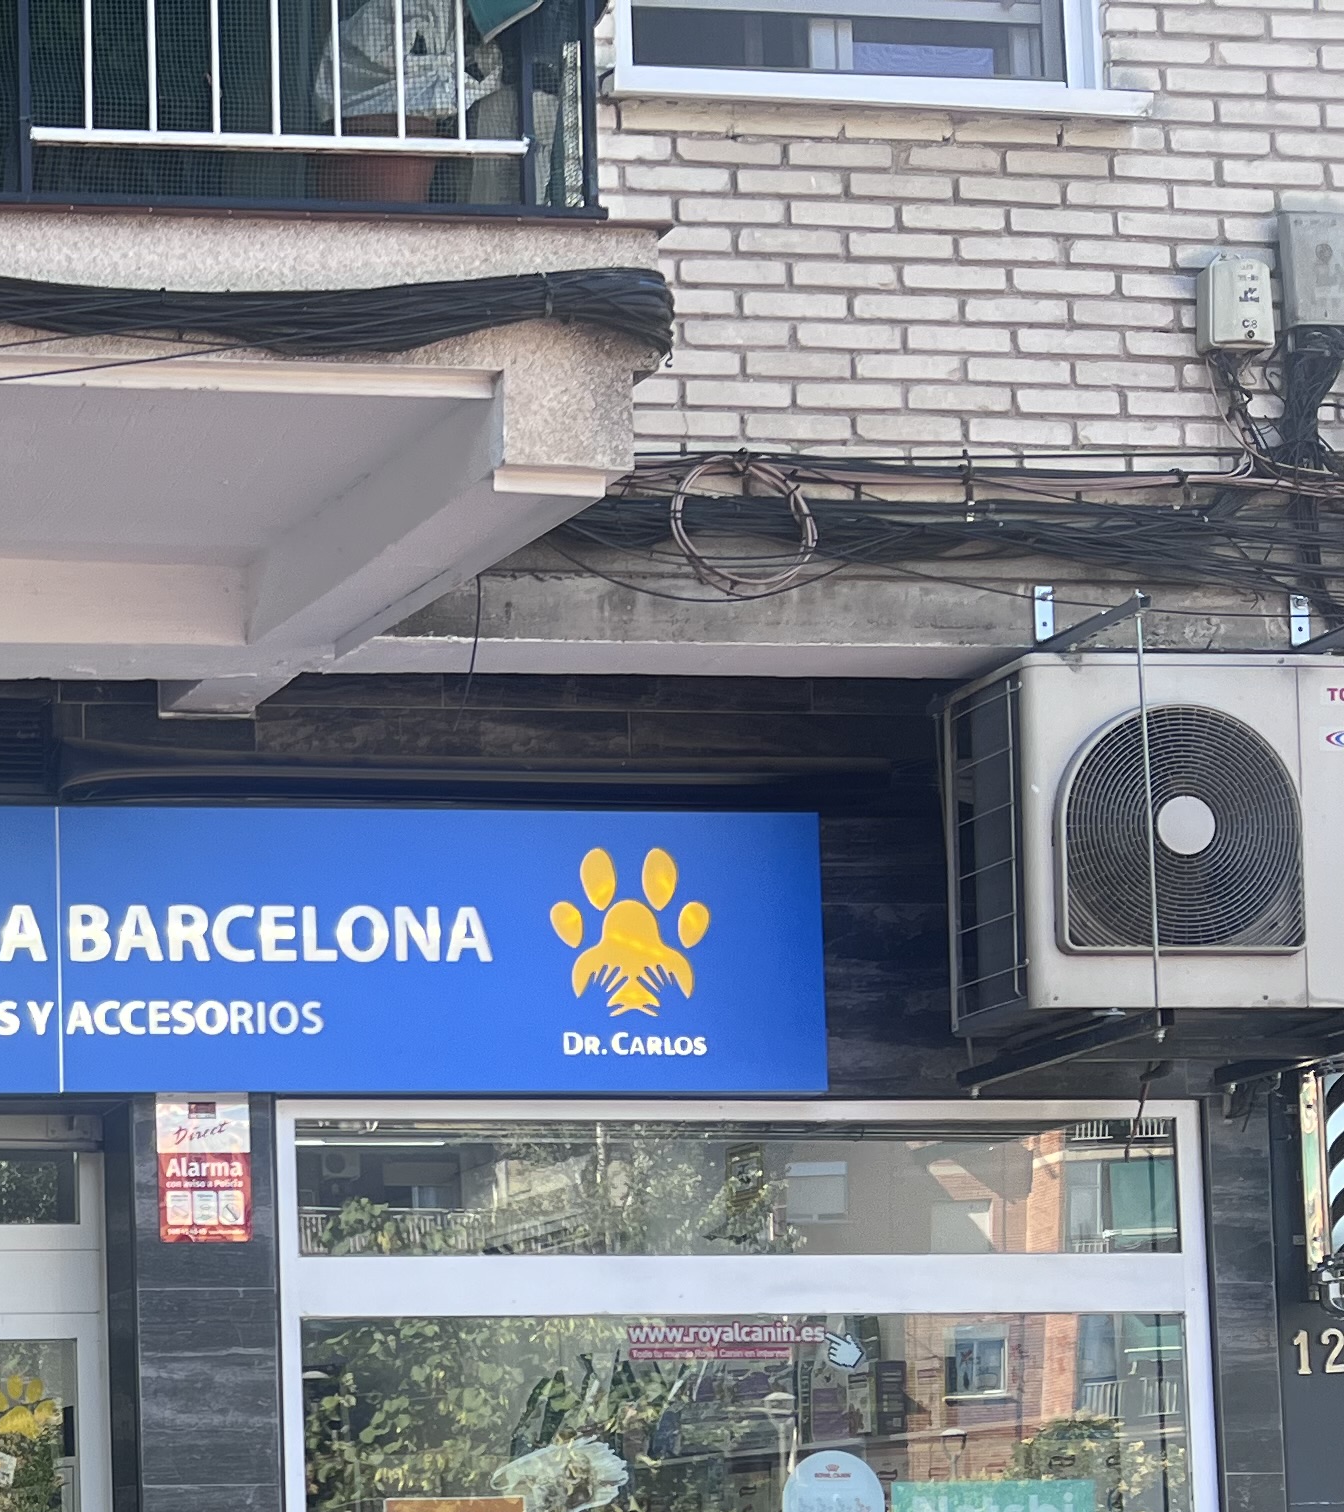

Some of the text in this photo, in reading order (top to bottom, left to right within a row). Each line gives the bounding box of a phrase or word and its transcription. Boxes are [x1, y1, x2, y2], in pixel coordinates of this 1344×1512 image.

[68, 904, 494, 963] BARCELONA
[27, 1001, 55, 1036] Y
[65, 1000, 325, 1036] ACCESORIOS
[174, 1120, 232, 1145] Direct
[166, 1157, 243, 1177] Alarma
[628, 1321, 824, 1346] www.royalcanin.es
[1293, 1327, 1344, 1376] 12
